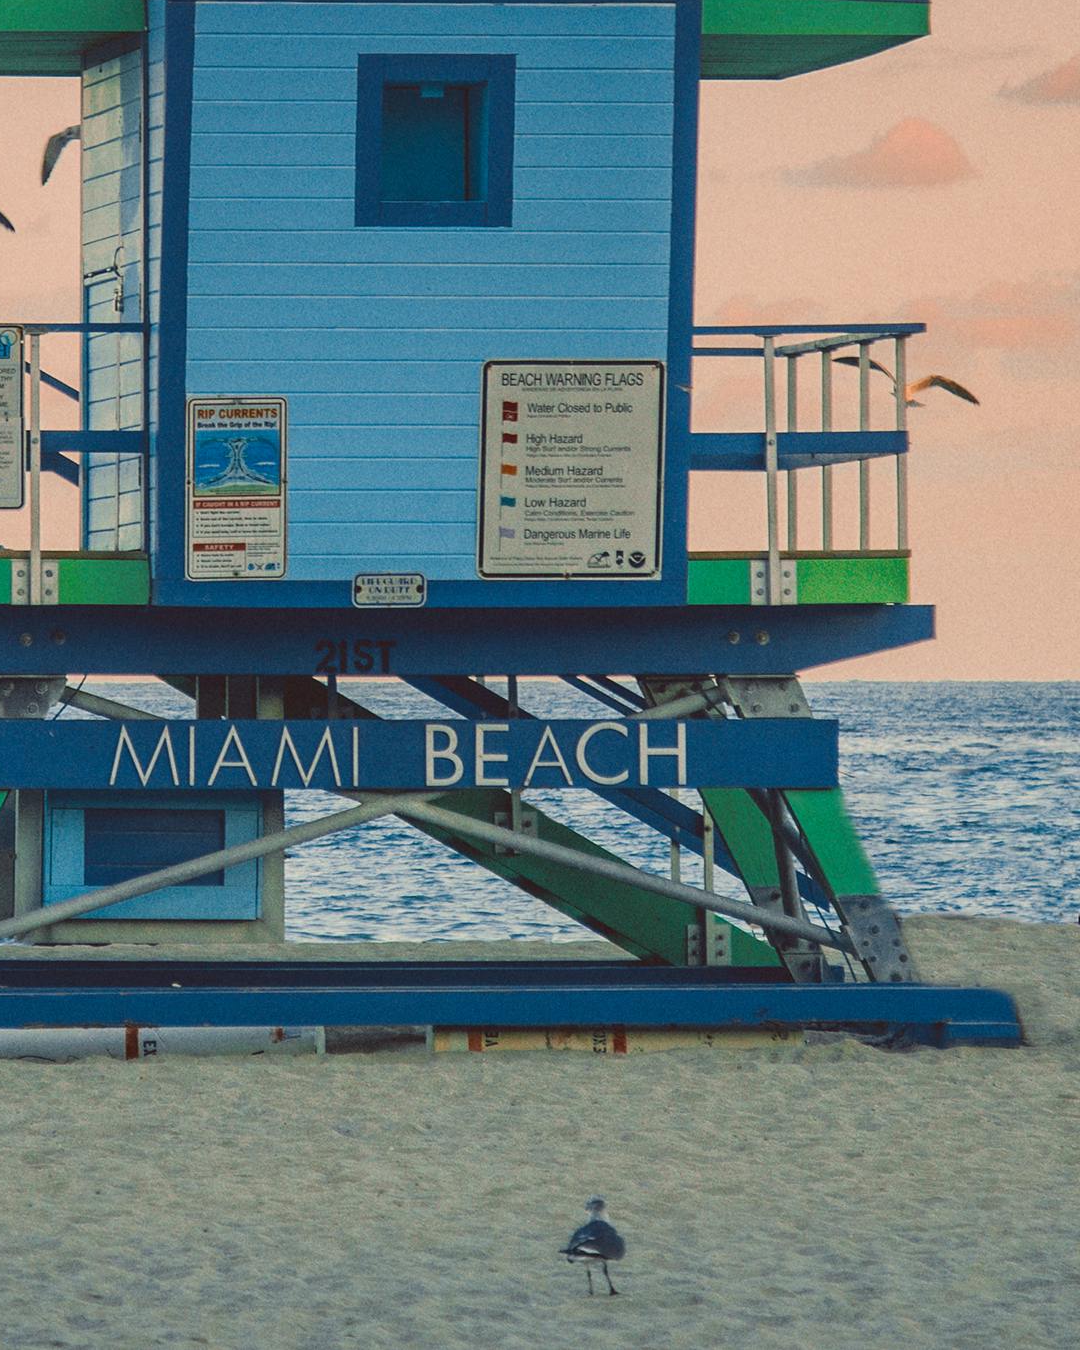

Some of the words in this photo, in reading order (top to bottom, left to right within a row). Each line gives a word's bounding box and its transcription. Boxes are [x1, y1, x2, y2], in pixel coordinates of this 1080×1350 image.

[502, 373, 542, 386] BEACH
[545, 373, 601, 386] WARNING
[605, 373, 644, 386] FLAGS
[197, 409, 215, 418] RIP
[219, 408, 277, 418] CURRENTS
[527, 403, 555, 413] Water
[558, 403, 590, 413] Closed
[593, 403, 602, 413] to
[605, 403, 633, 413] Public
[229, 421, 242, 429] Grip
[526, 433, 546, 446] High
[549, 433, 583, 443] Hazard
[525, 466, 564, 475] Medium
[567, 466, 603, 475] Hazard
[525, 498, 545, 507] Low
[548, 498, 586, 507] Hazard
[523, 529, 576, 541] Dangerous
[579, 529, 610, 539] Marine
[614, 529, 631, 539] Life
[315, 639, 397, 674] 21ST
[108, 725, 359, 787] MIAMI
[425, 722, 687, 787] BEACH
